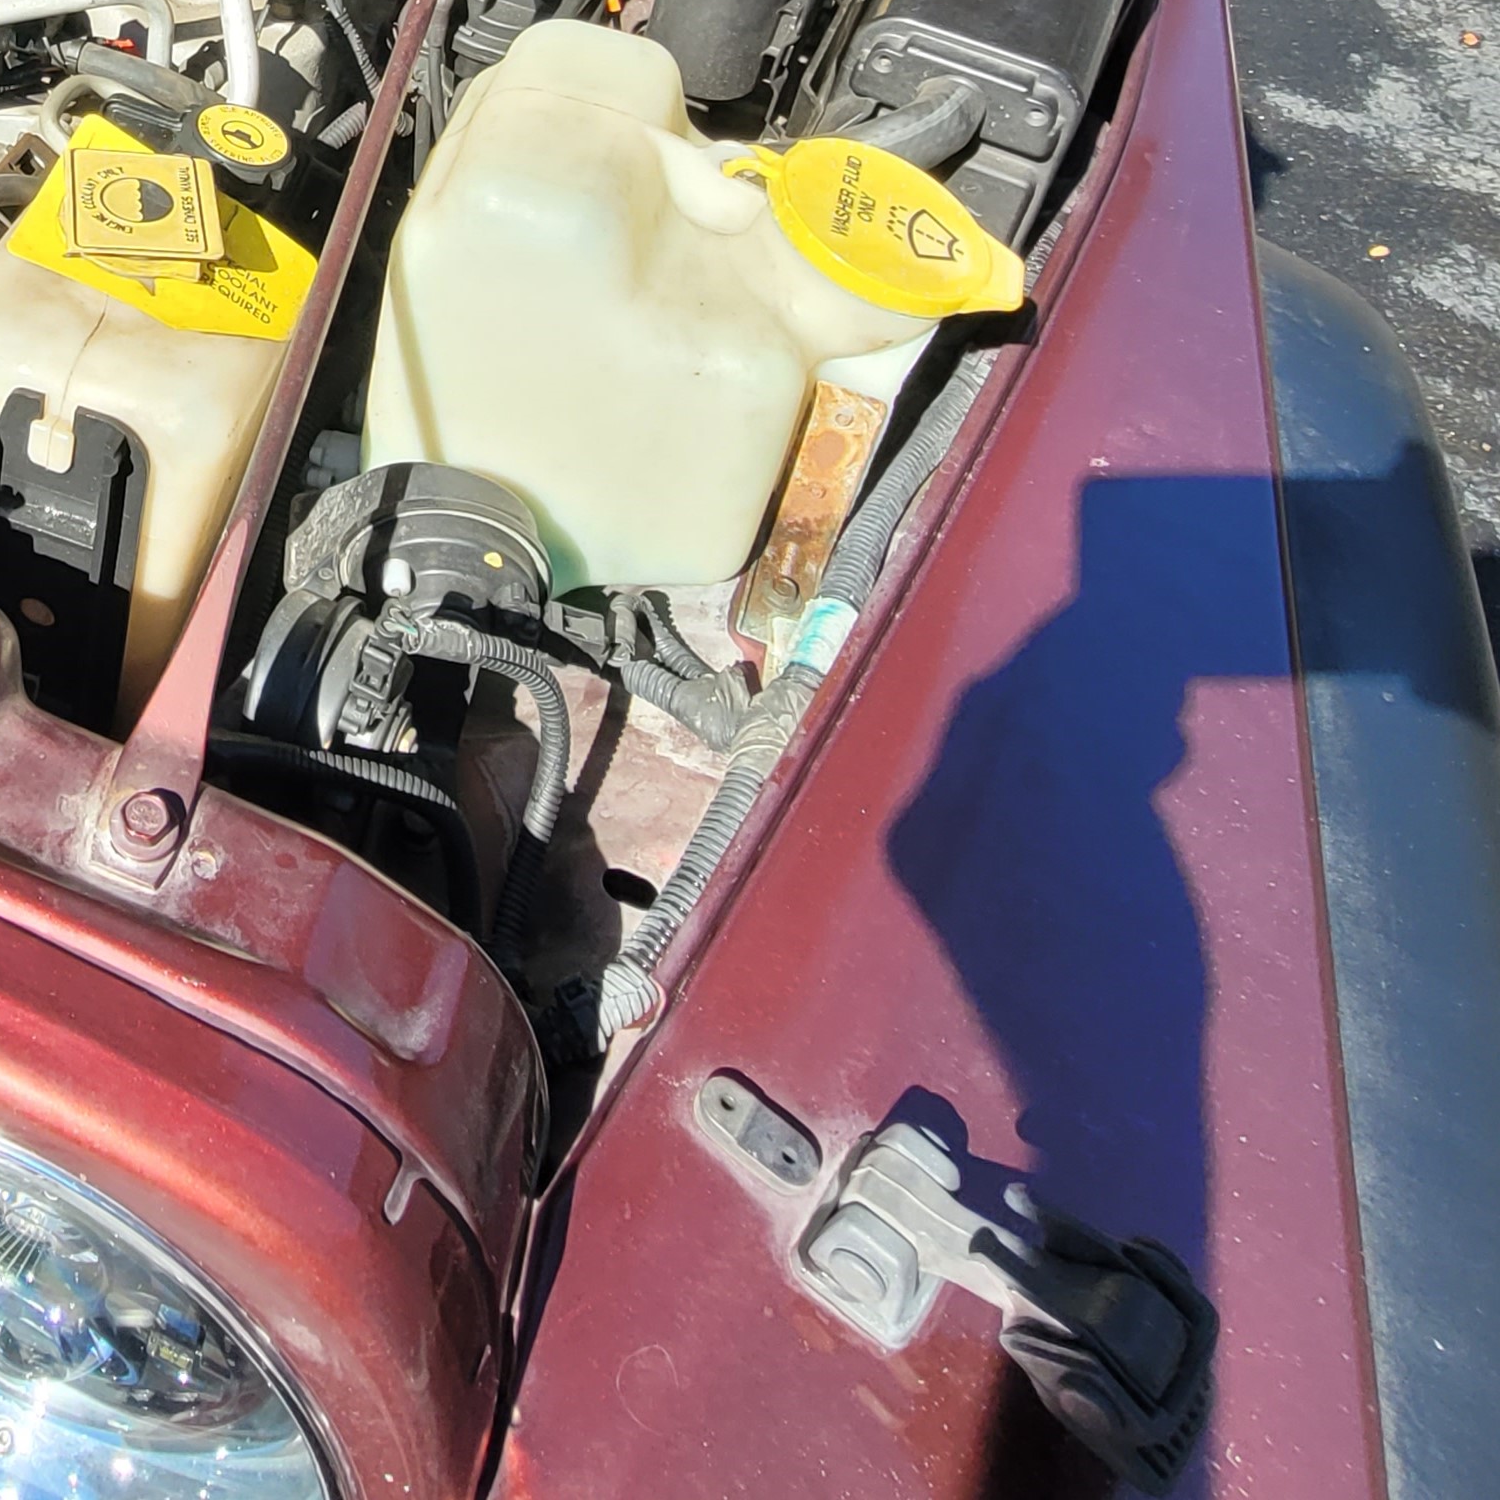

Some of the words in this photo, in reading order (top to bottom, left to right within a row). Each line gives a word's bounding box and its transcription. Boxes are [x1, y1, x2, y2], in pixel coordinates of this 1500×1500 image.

[842, 155, 862, 189] FLUID
[830, 188, 856, 237] WASHER
[856, 190, 876, 223] ONLY
[200, 272, 271, 324] REQUIRED
[206, 261, 278, 313] COOLANT
